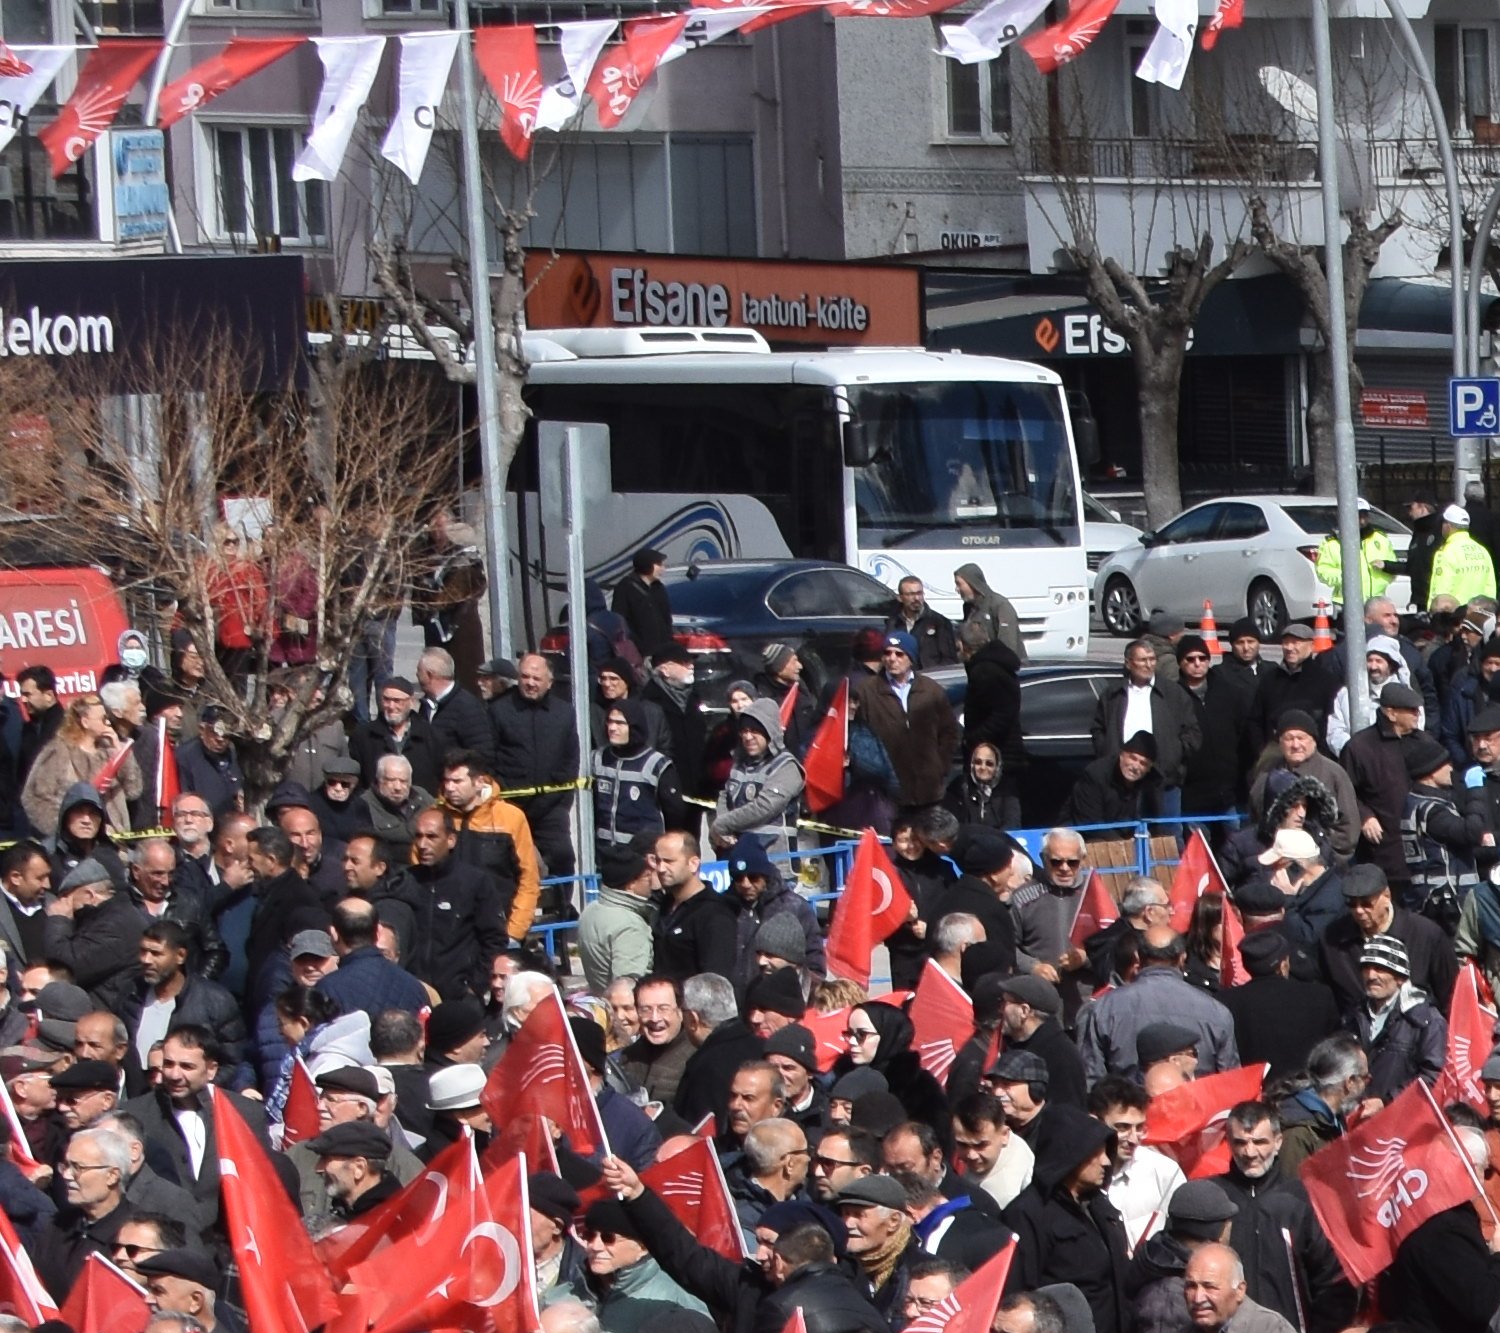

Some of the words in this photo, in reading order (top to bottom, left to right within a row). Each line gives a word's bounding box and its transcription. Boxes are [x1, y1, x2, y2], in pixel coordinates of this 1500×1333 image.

[610, 268, 728, 328] Efsane
[738, 292, 867, 332] tantuni-köfte
[1065, 314, 1194, 354] Efs
[1456, 386, 1481, 428] P
